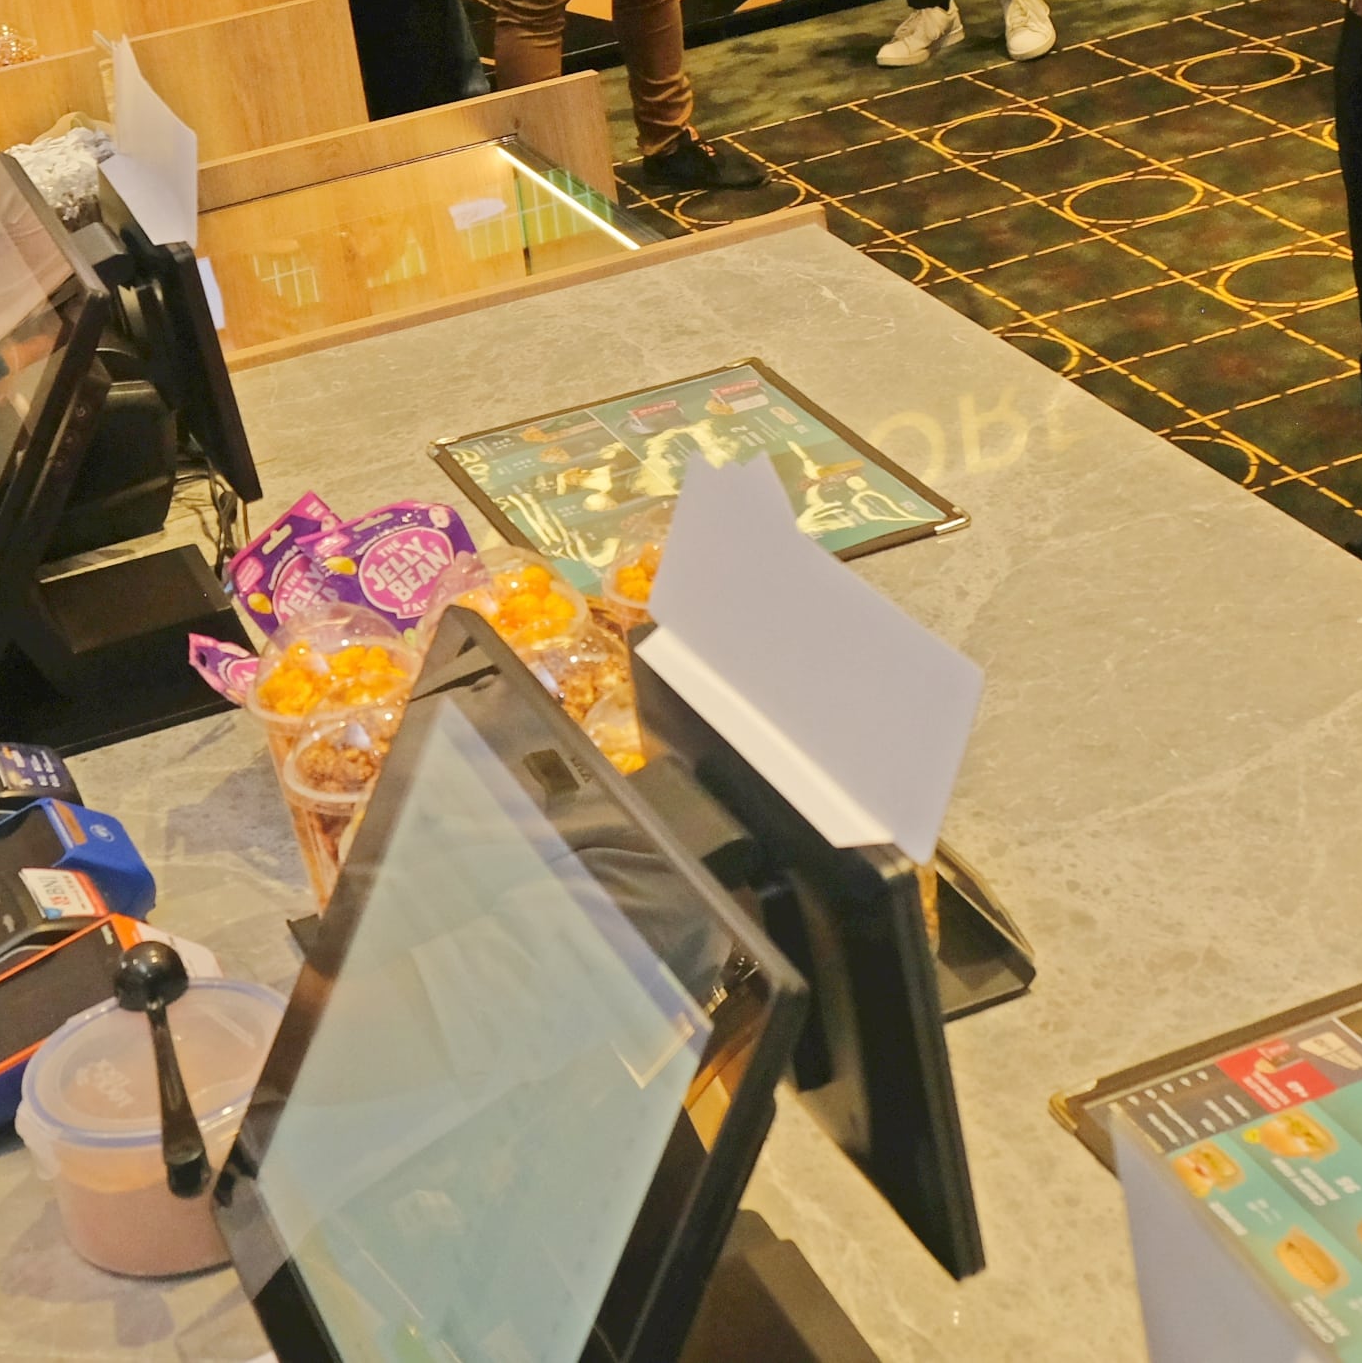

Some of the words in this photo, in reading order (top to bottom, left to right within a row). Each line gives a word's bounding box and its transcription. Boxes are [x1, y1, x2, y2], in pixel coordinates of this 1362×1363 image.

[364, 536, 429, 592] JELLY
[378, 539, 402, 558] THE
[387, 546, 450, 602] BEAN
